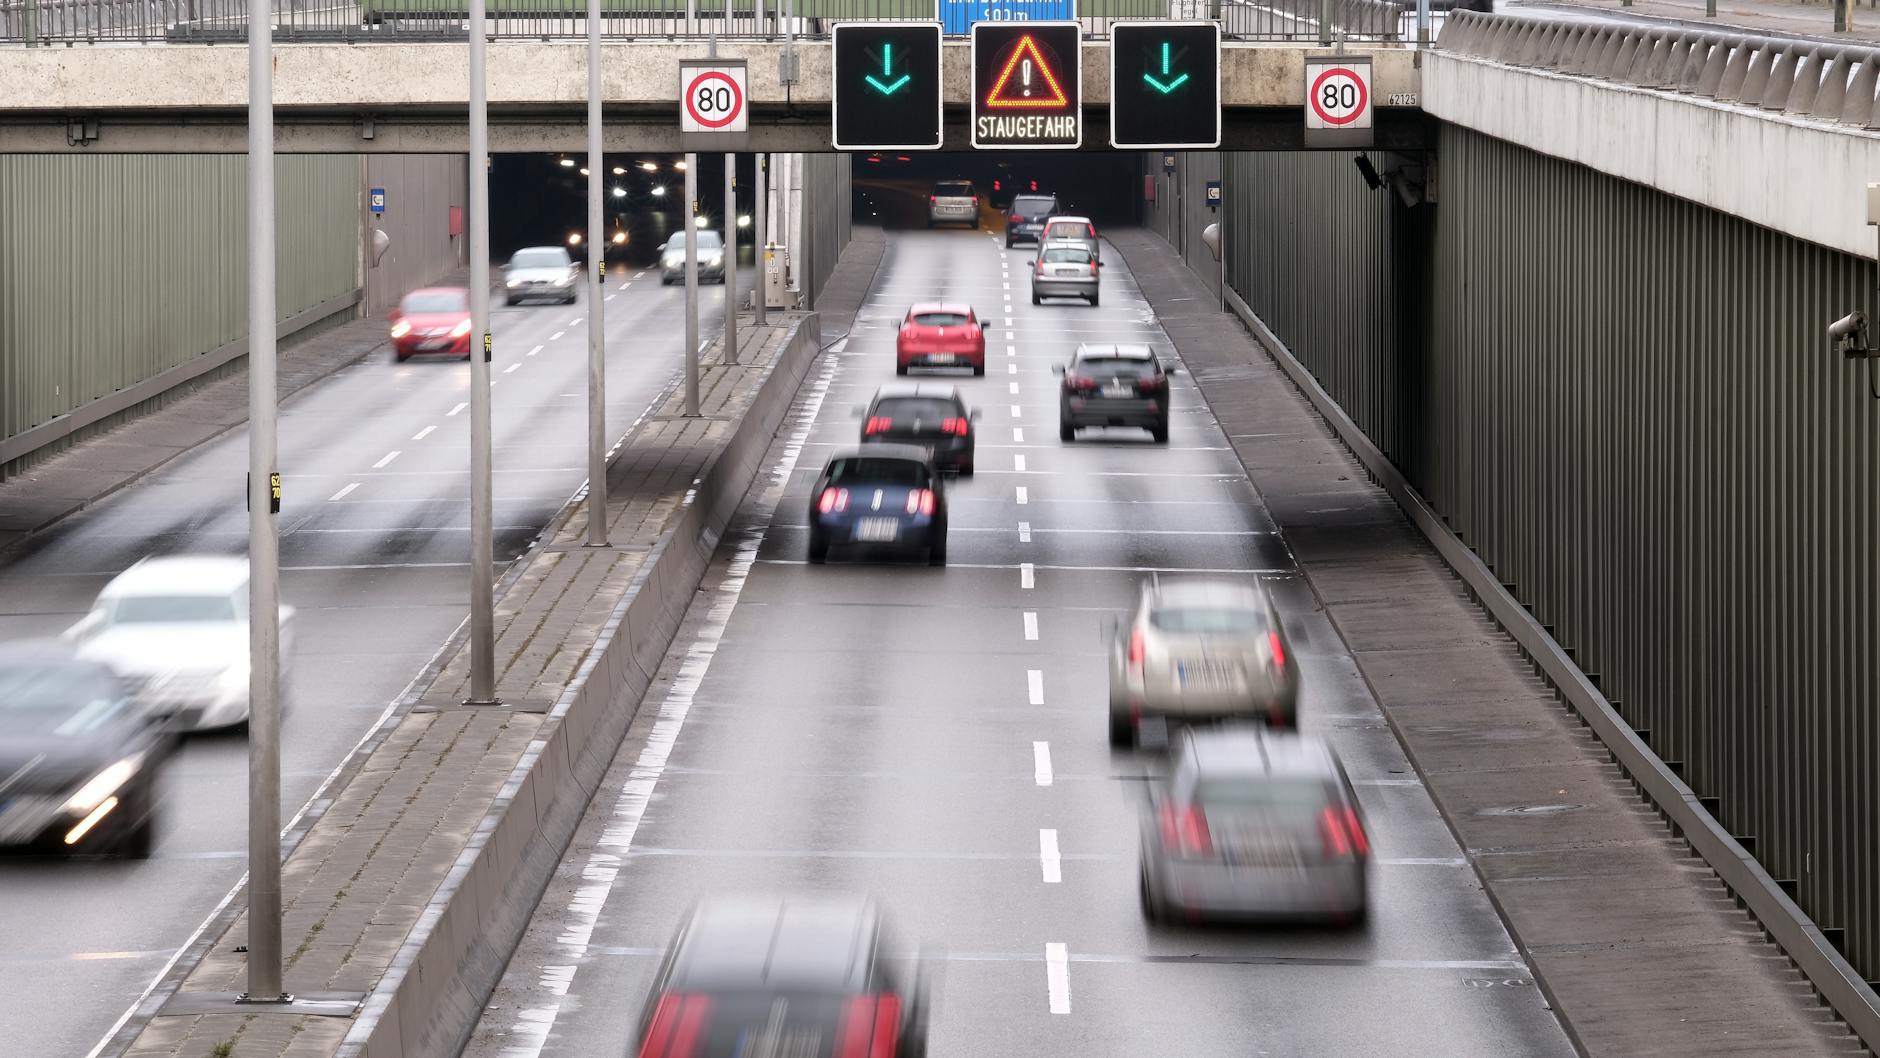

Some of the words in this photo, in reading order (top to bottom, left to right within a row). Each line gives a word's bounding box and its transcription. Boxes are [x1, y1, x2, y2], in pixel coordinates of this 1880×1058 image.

[698, 87, 730, 112] 80
[1323, 84, 1355, 109] 80
[1389, 94, 1416, 105] 62125
[978, 116, 1075, 138] STAUGEFAHR
[271, 475, 280, 487] 62
